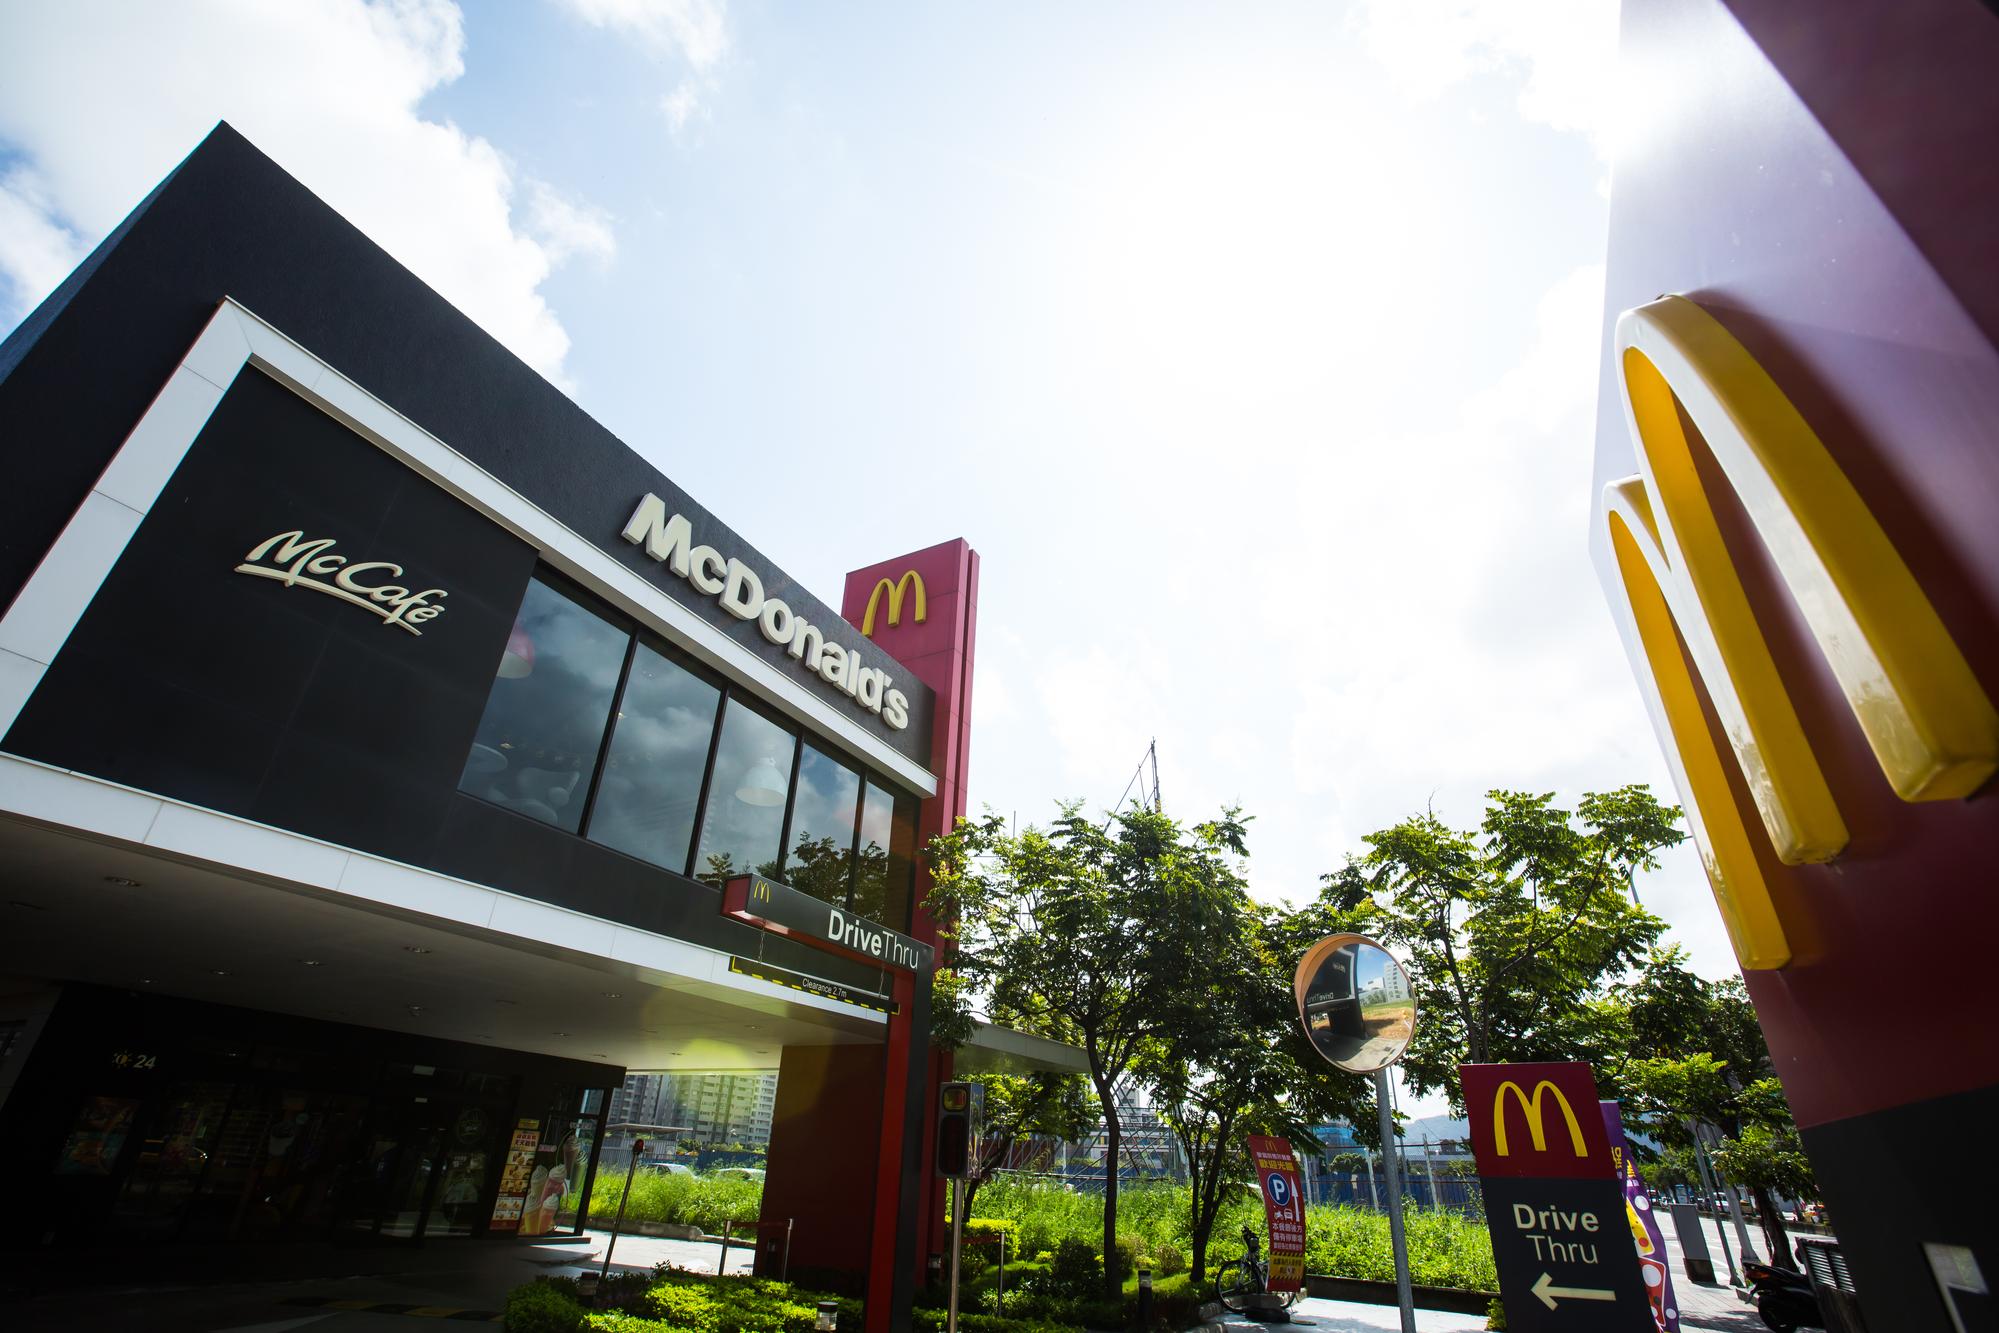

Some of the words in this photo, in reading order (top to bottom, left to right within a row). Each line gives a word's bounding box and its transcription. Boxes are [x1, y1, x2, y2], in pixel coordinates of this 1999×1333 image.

[245, 530, 448, 625] McCafé
[621, 492, 909, 730] McDonald's
[802, 977, 833, 994] Clearance
[832, 986, 847, 998] 2.7m
[132, 1054, 157, 1070] 24
[1272, 1178, 1285, 1201] P
[1512, 1203, 1600, 1233] Drive
[1525, 1234, 1599, 1265] Thru
